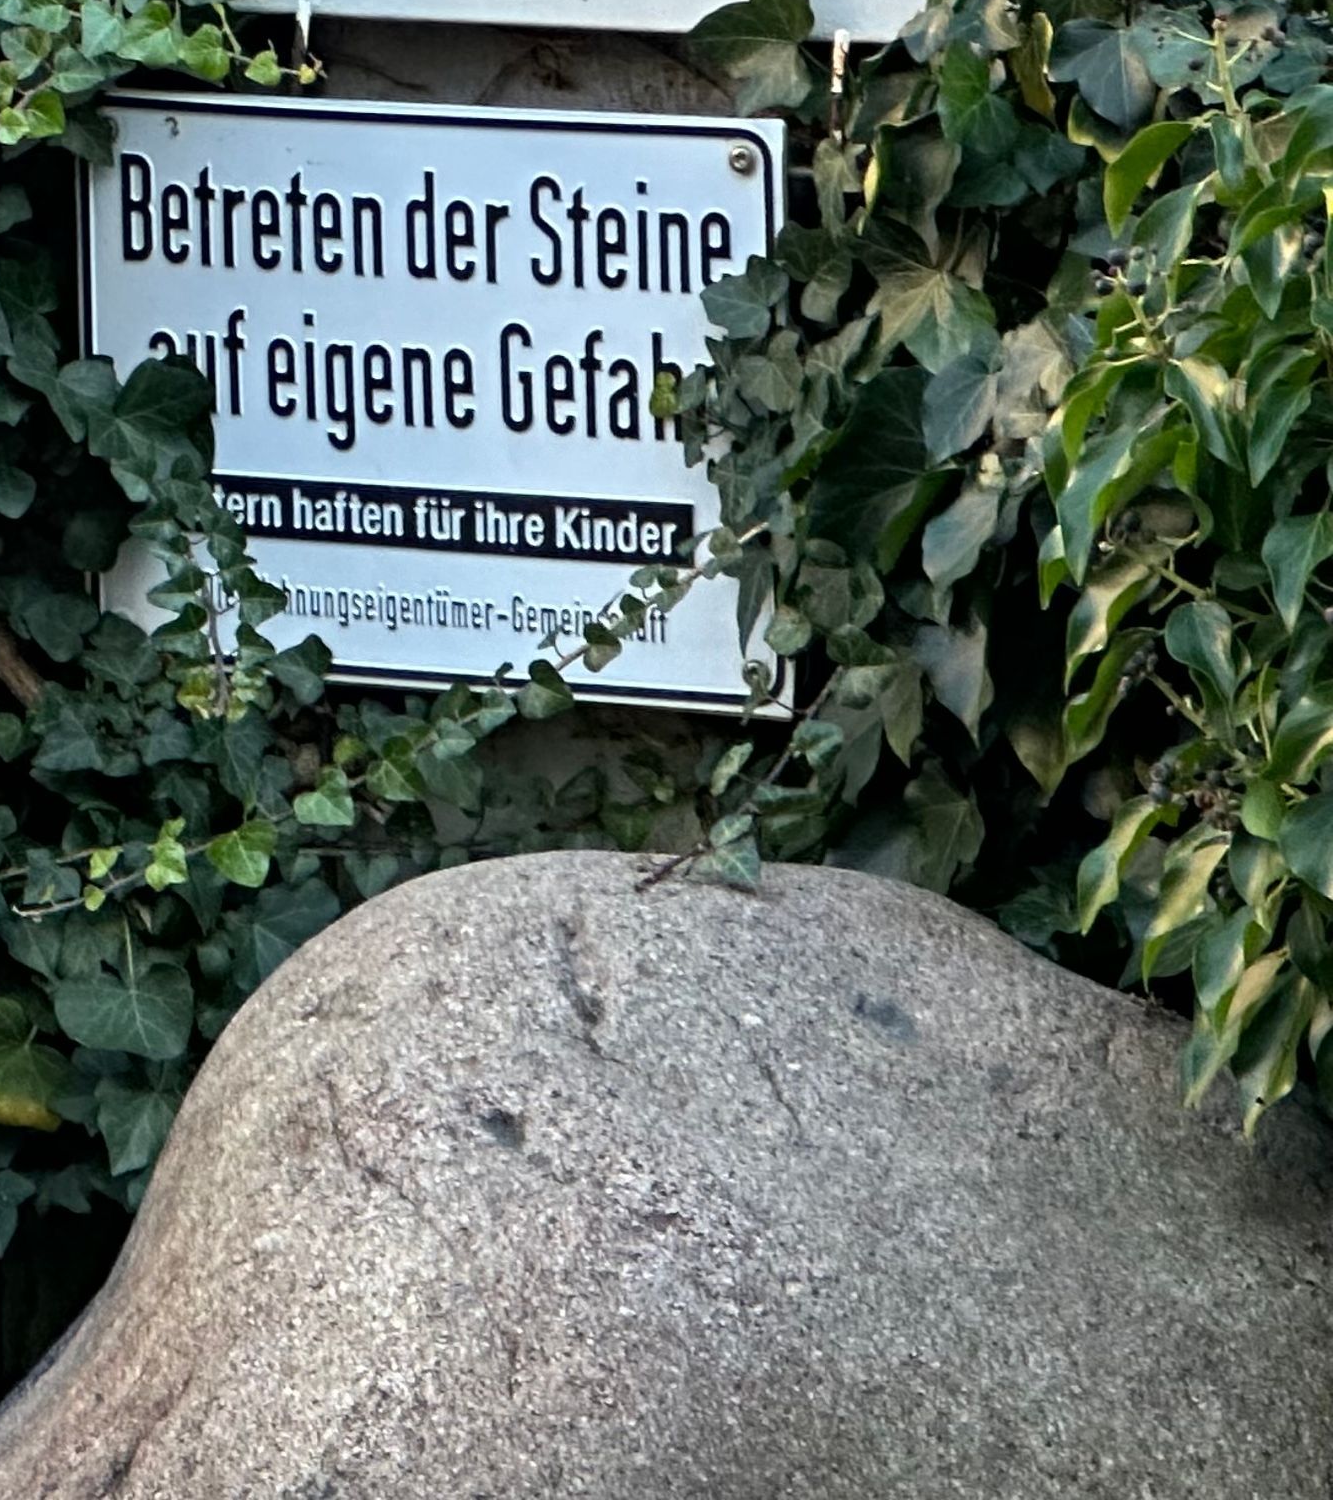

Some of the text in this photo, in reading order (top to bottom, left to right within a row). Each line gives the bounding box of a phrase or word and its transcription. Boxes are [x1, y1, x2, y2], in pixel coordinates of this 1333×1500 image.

[120, 152, 733, 295] Betreten der Steine
[148, 307, 247, 417] uf
[266, 311, 475, 451] eigene
[212, 483, 679, 556] tern haften für ihre Kinder
